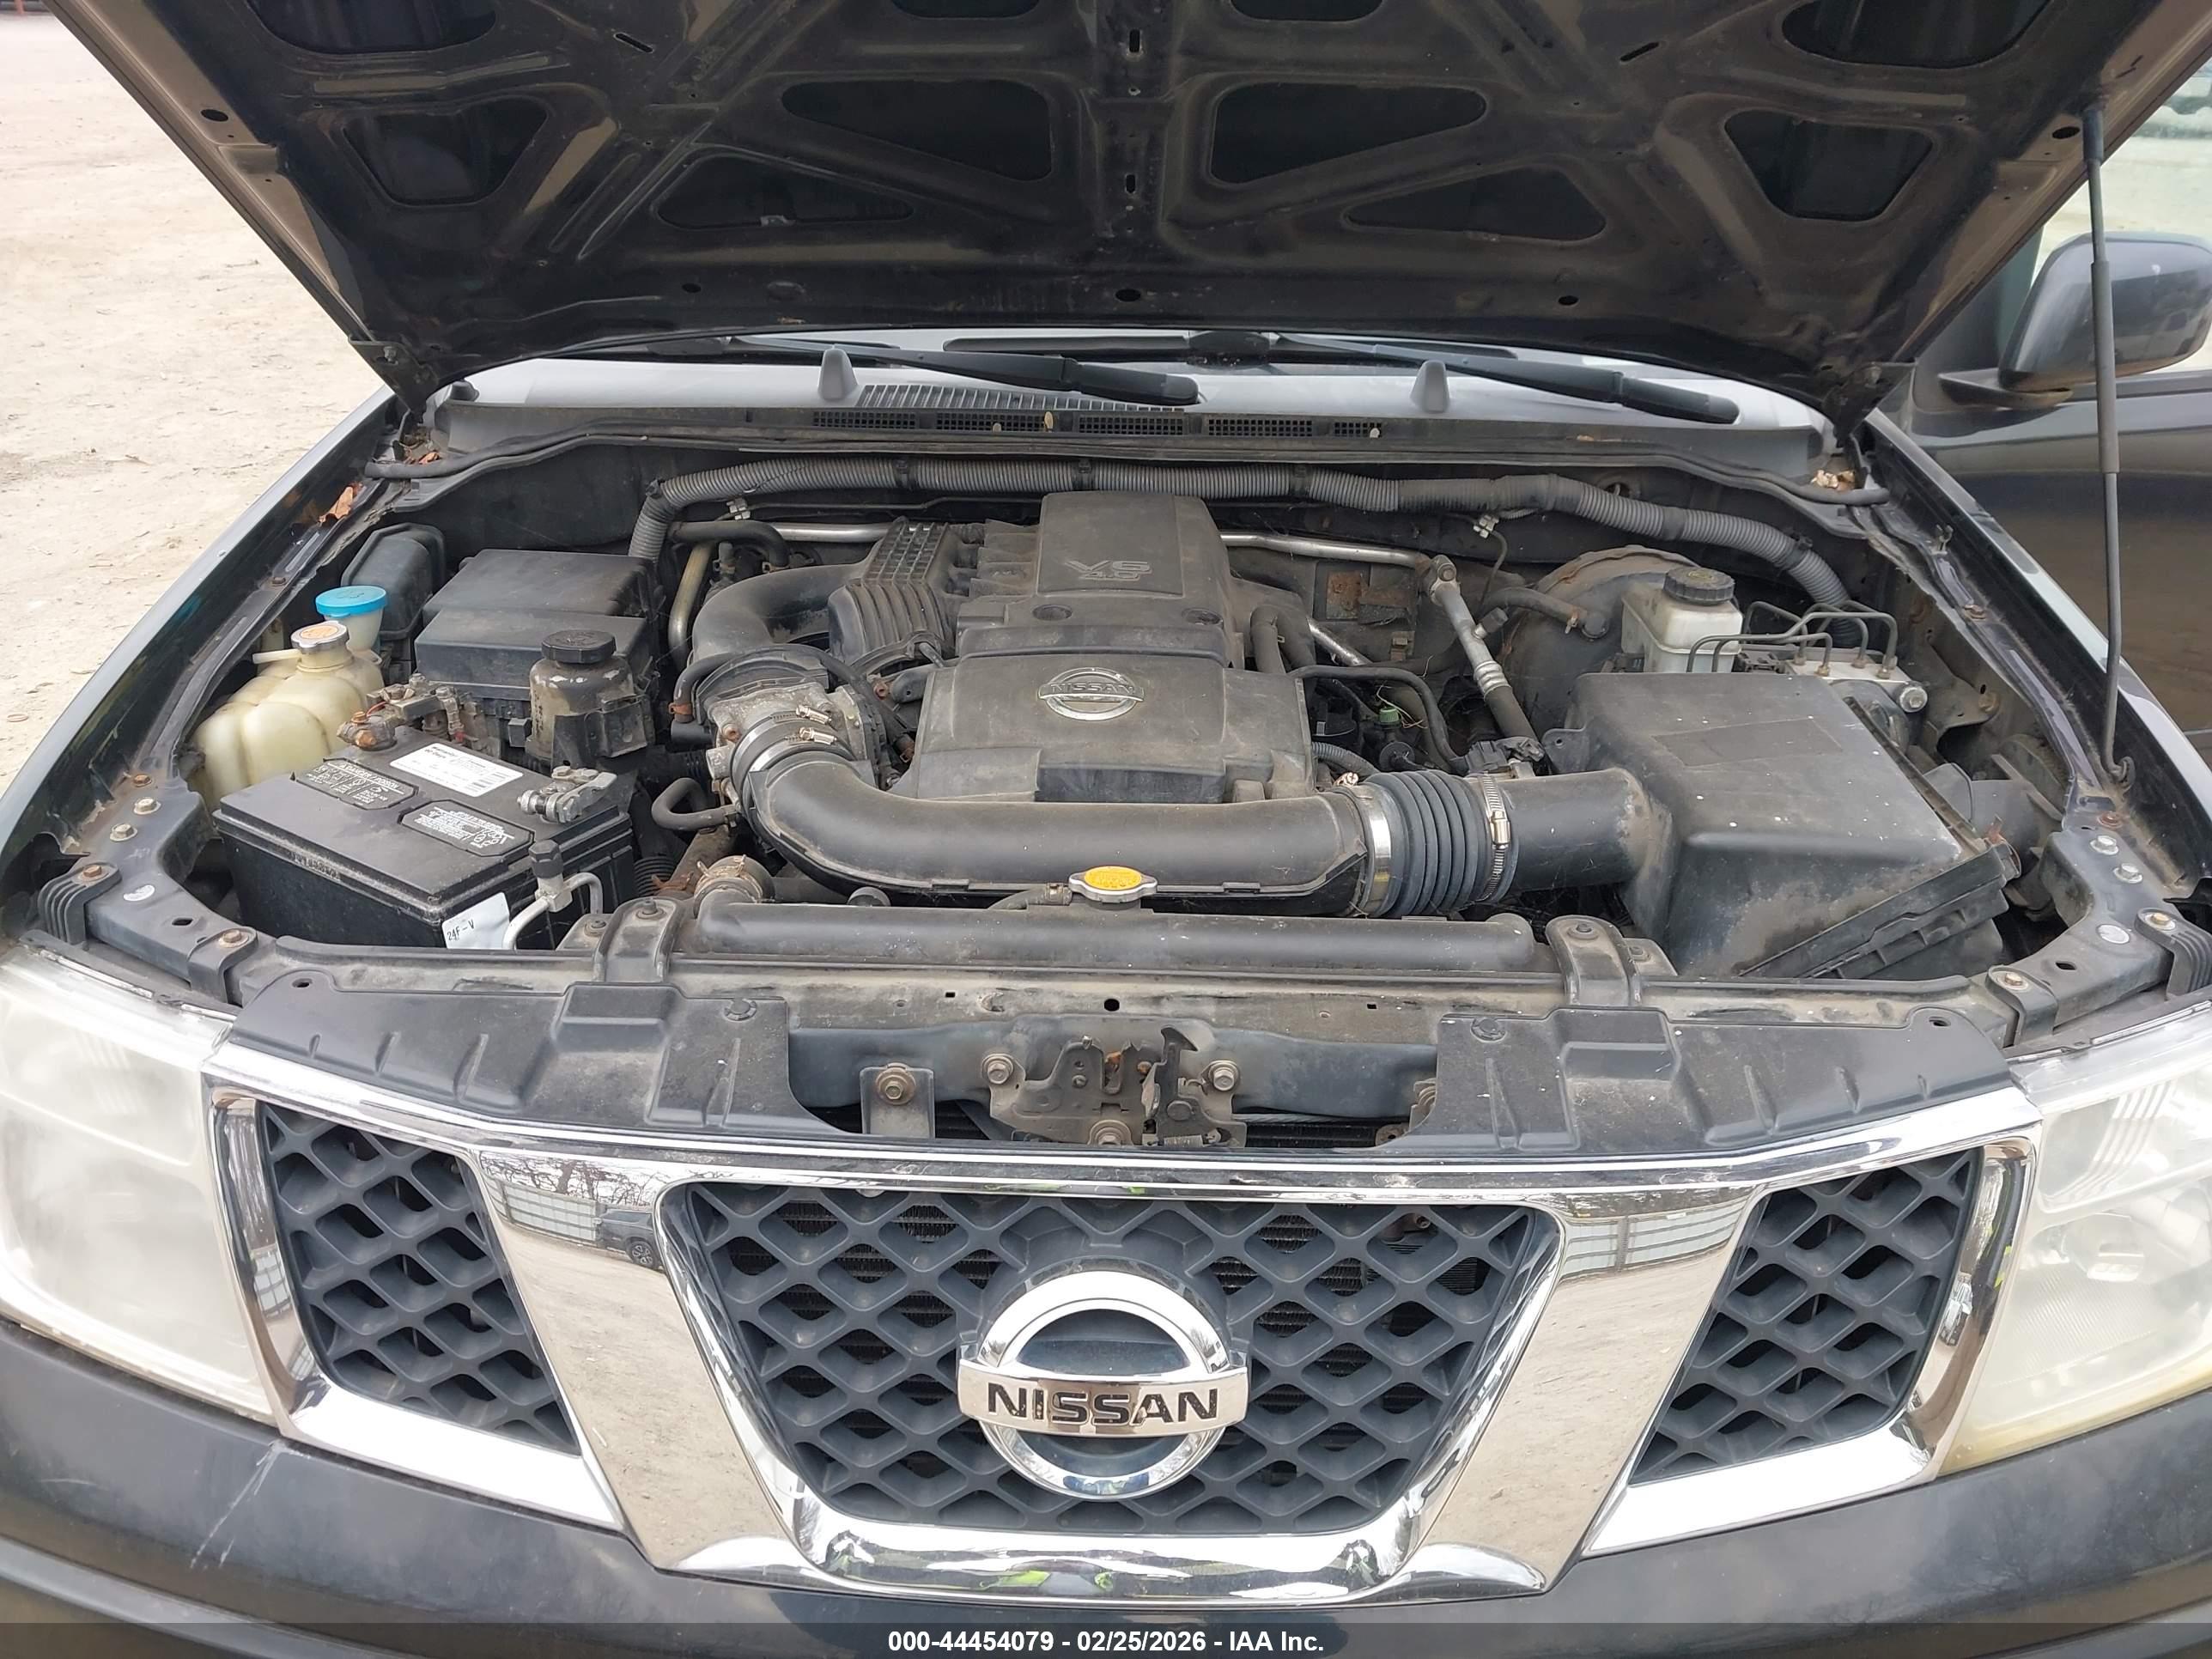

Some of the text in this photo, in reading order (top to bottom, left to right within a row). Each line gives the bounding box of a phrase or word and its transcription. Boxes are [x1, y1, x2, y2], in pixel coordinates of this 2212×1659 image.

[1065, 559, 1152, 574] V6
[1049, 682, 1134, 695] NISSAN
[988, 1382, 1218, 1425] NISSAN
